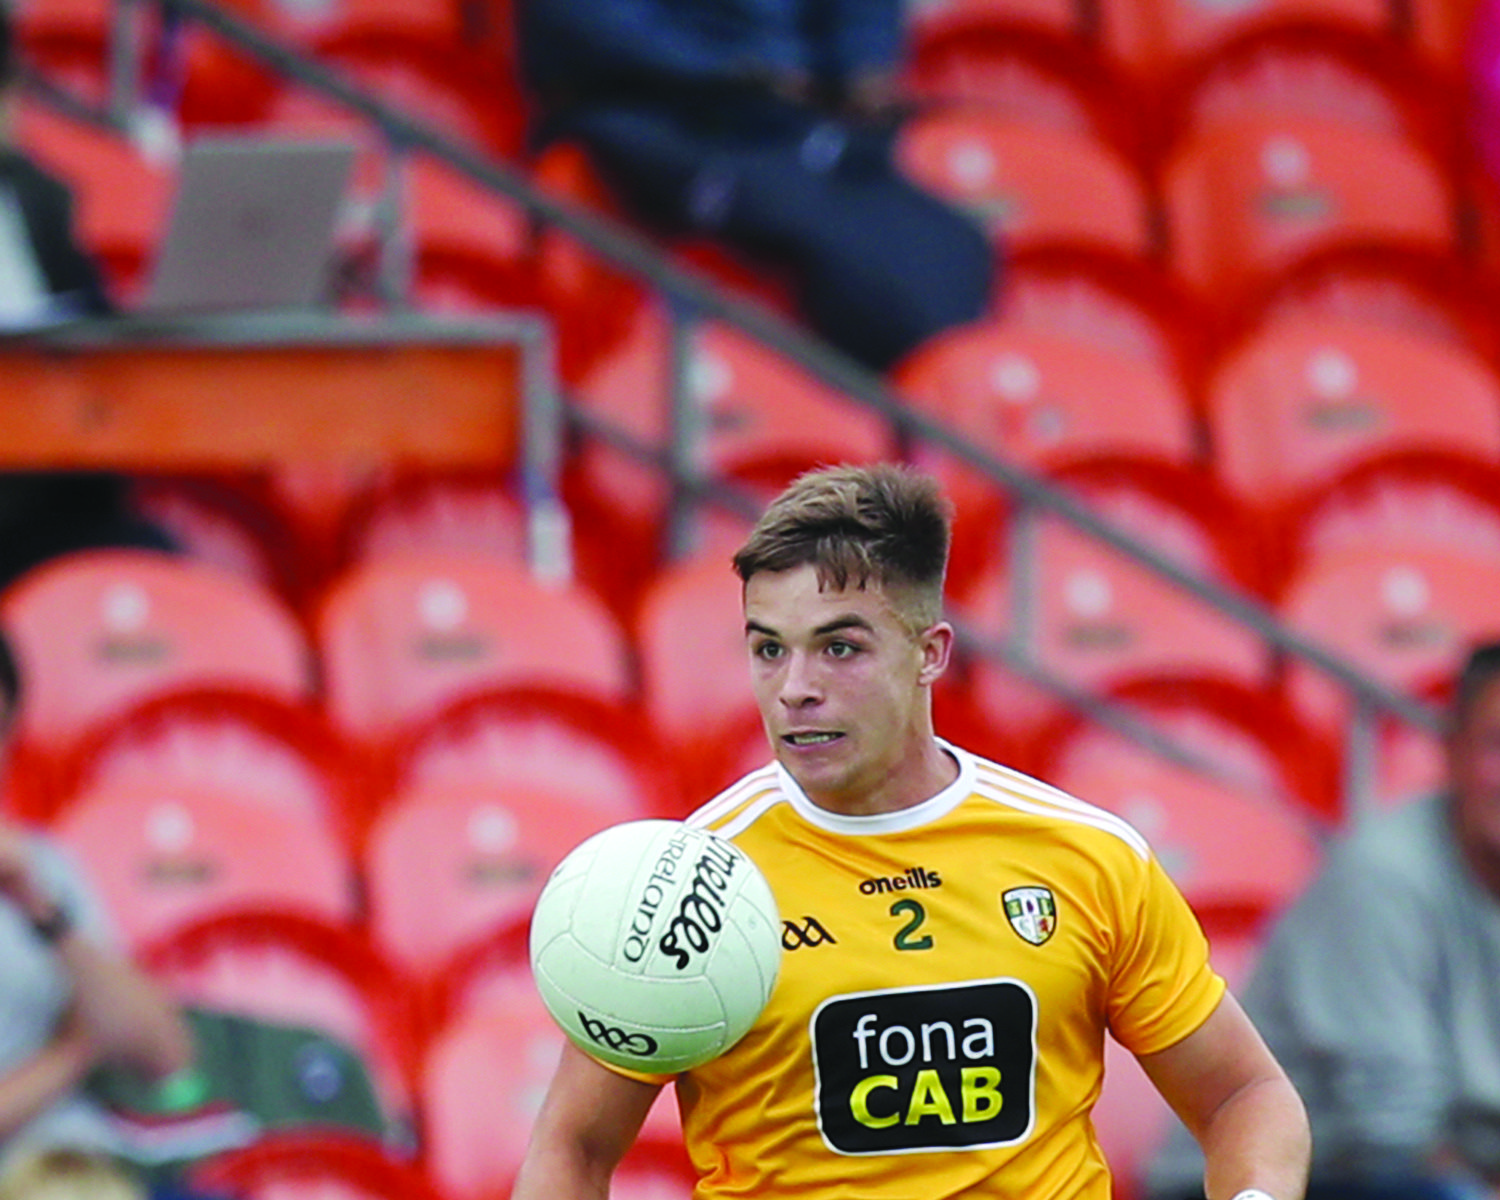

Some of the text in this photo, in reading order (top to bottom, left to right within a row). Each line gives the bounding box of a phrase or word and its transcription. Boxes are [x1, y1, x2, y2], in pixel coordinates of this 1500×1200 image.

[859, 867, 942, 895] oneills
[890, 899, 933, 950] 2
[852, 1014, 996, 1068] fona
[849, 1067, 1004, 1129] CAB
